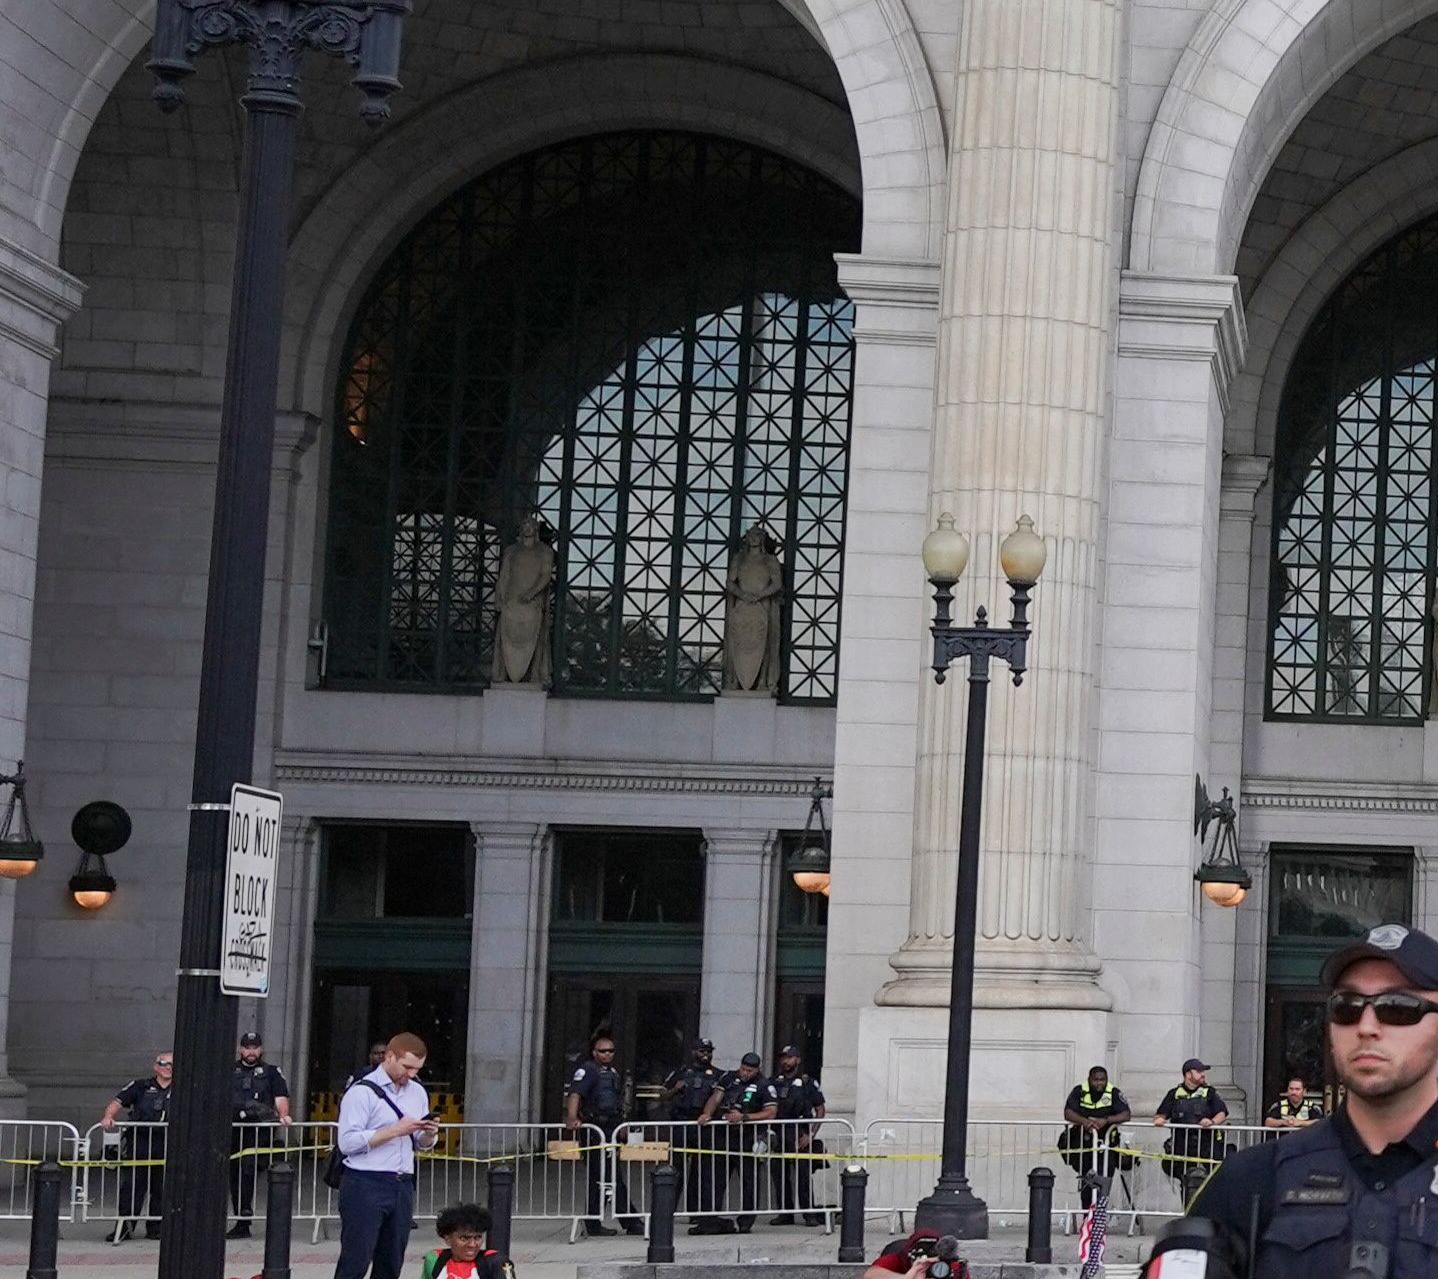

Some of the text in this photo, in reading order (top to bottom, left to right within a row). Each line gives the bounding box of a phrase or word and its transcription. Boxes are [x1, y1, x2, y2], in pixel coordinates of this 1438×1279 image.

[234, 812, 277, 859] DO NOT
[233, 873, 268, 918] BLOCK
